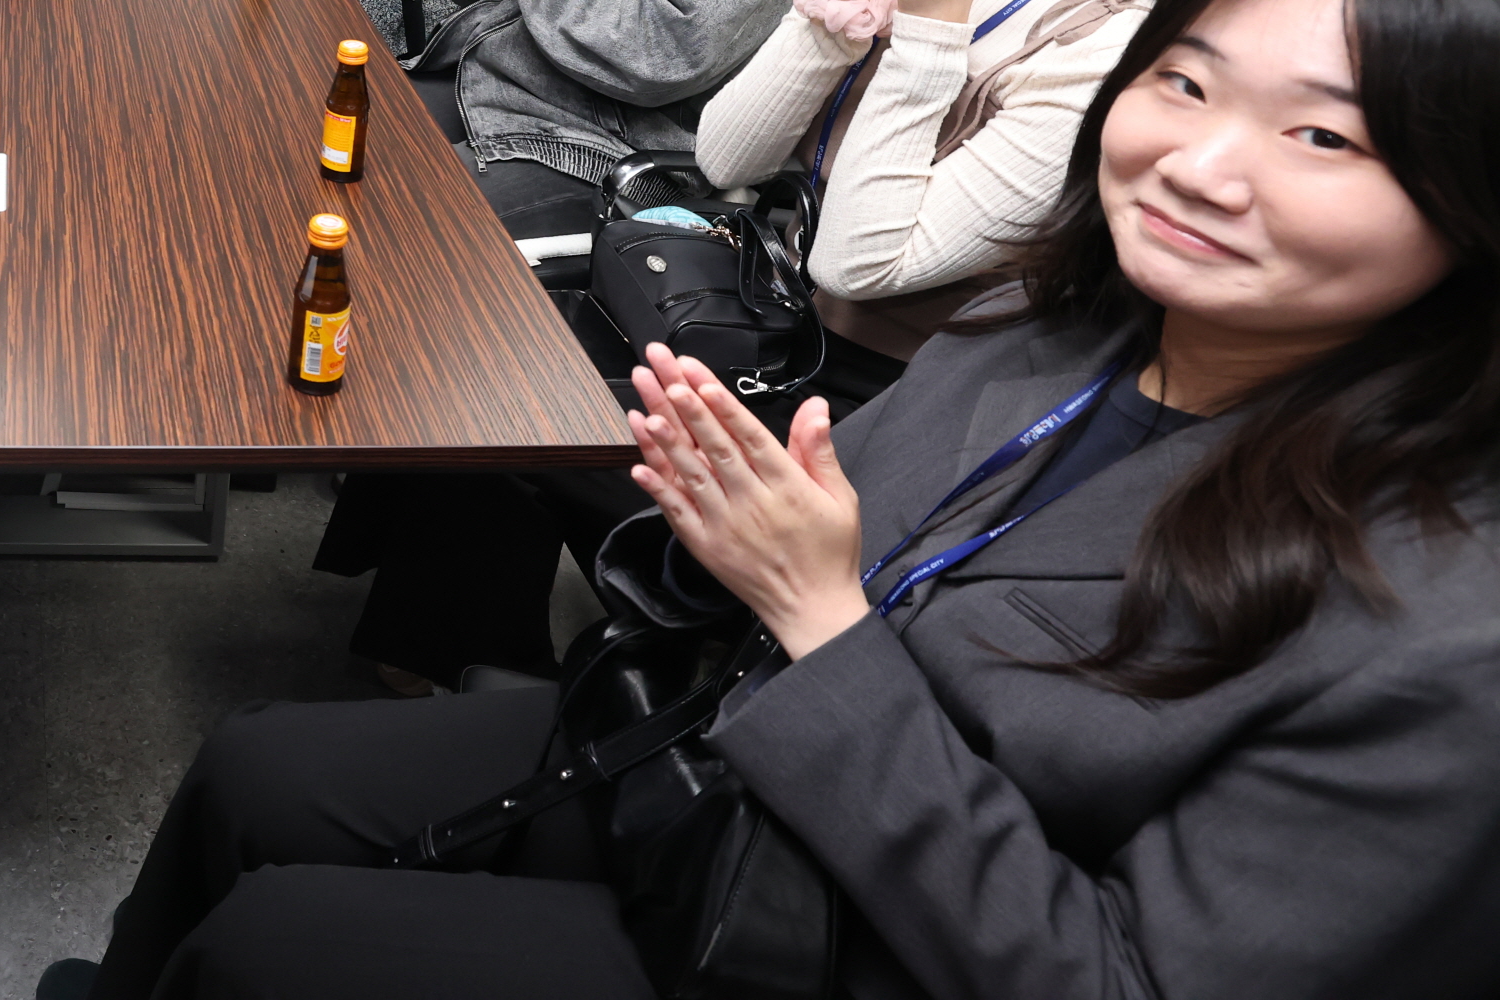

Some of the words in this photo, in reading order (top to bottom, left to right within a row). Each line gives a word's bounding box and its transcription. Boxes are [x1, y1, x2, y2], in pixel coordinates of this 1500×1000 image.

[1002, 3, 1014, 16] CITY
[908, 565, 931, 585] SPECIAL
[929, 558, 945, 570] CITY
